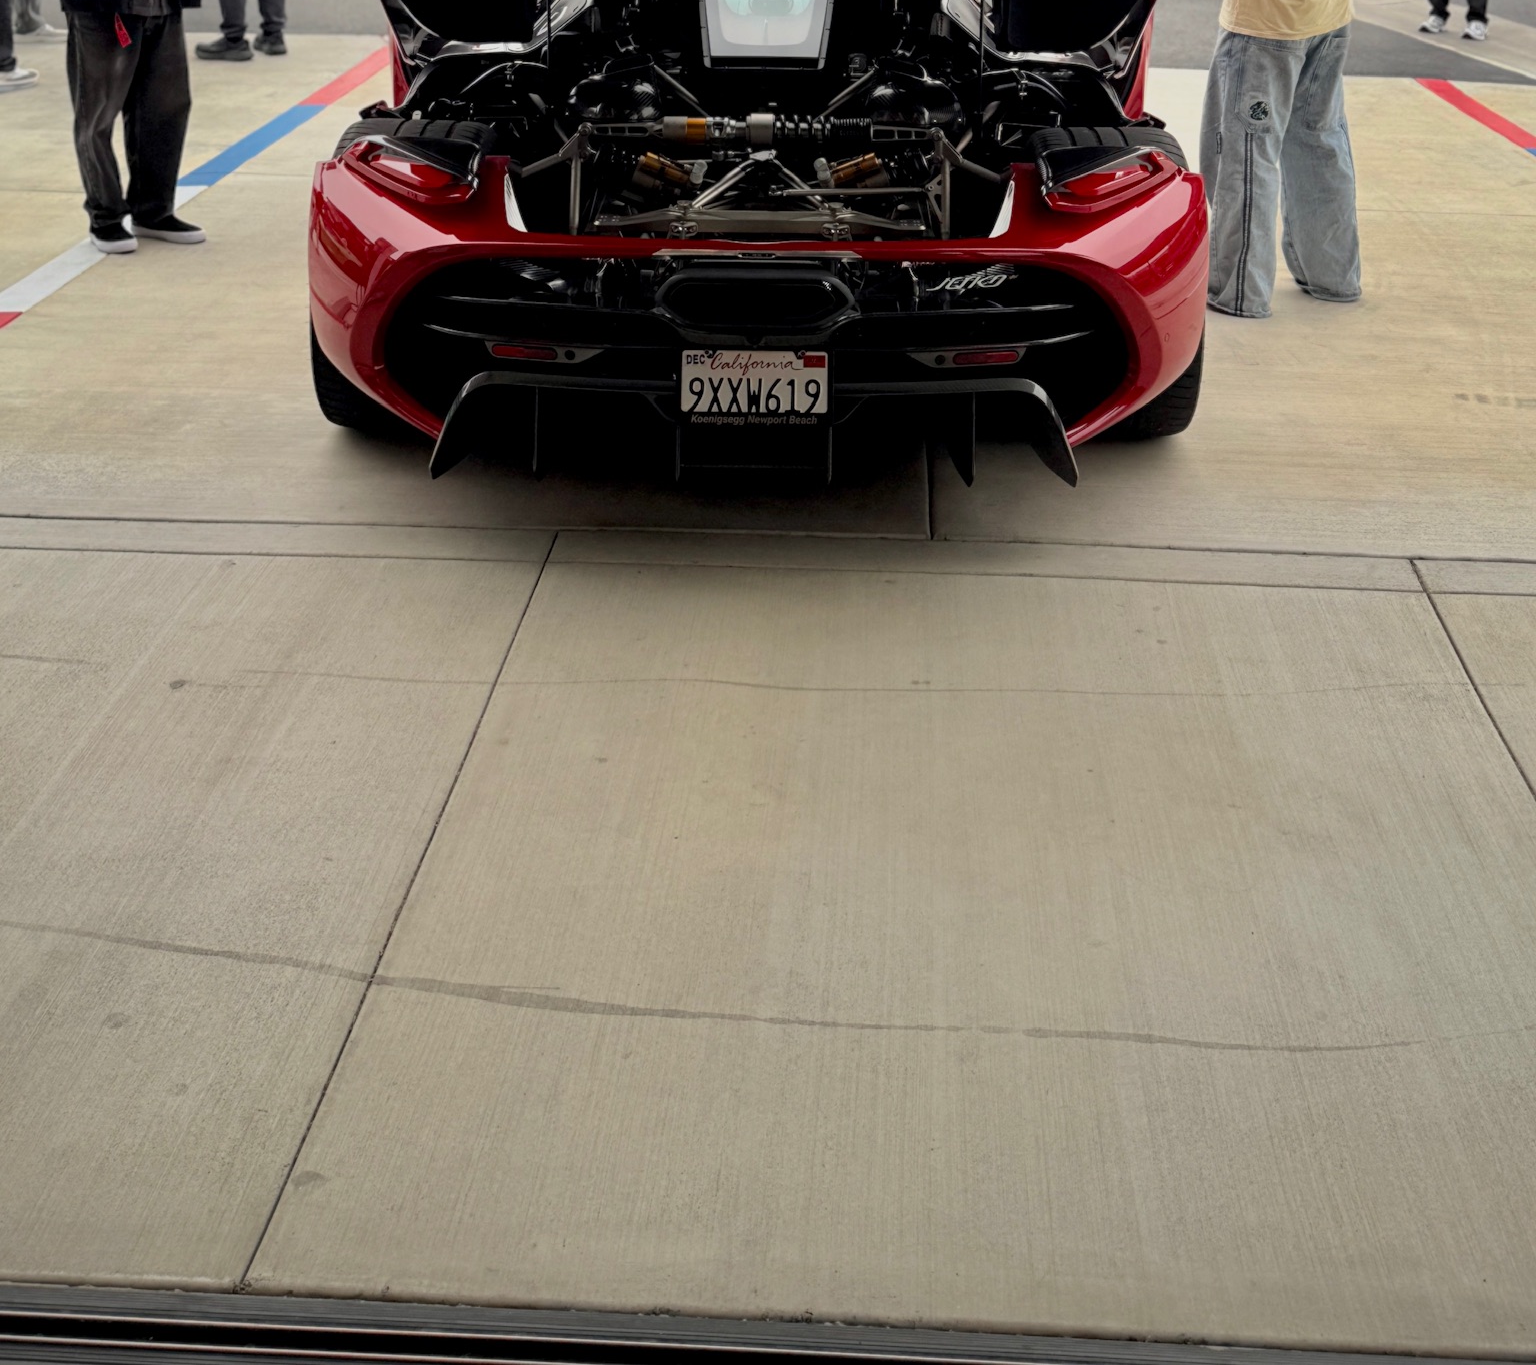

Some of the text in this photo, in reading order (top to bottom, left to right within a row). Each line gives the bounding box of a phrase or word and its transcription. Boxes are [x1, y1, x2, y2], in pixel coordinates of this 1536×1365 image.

[686, 354, 706, 365] DEC
[710, 352, 804, 376] California
[687, 377, 821, 413] 9XXW619
[691, 414, 818, 425] Koenigsegg Newport Beach
